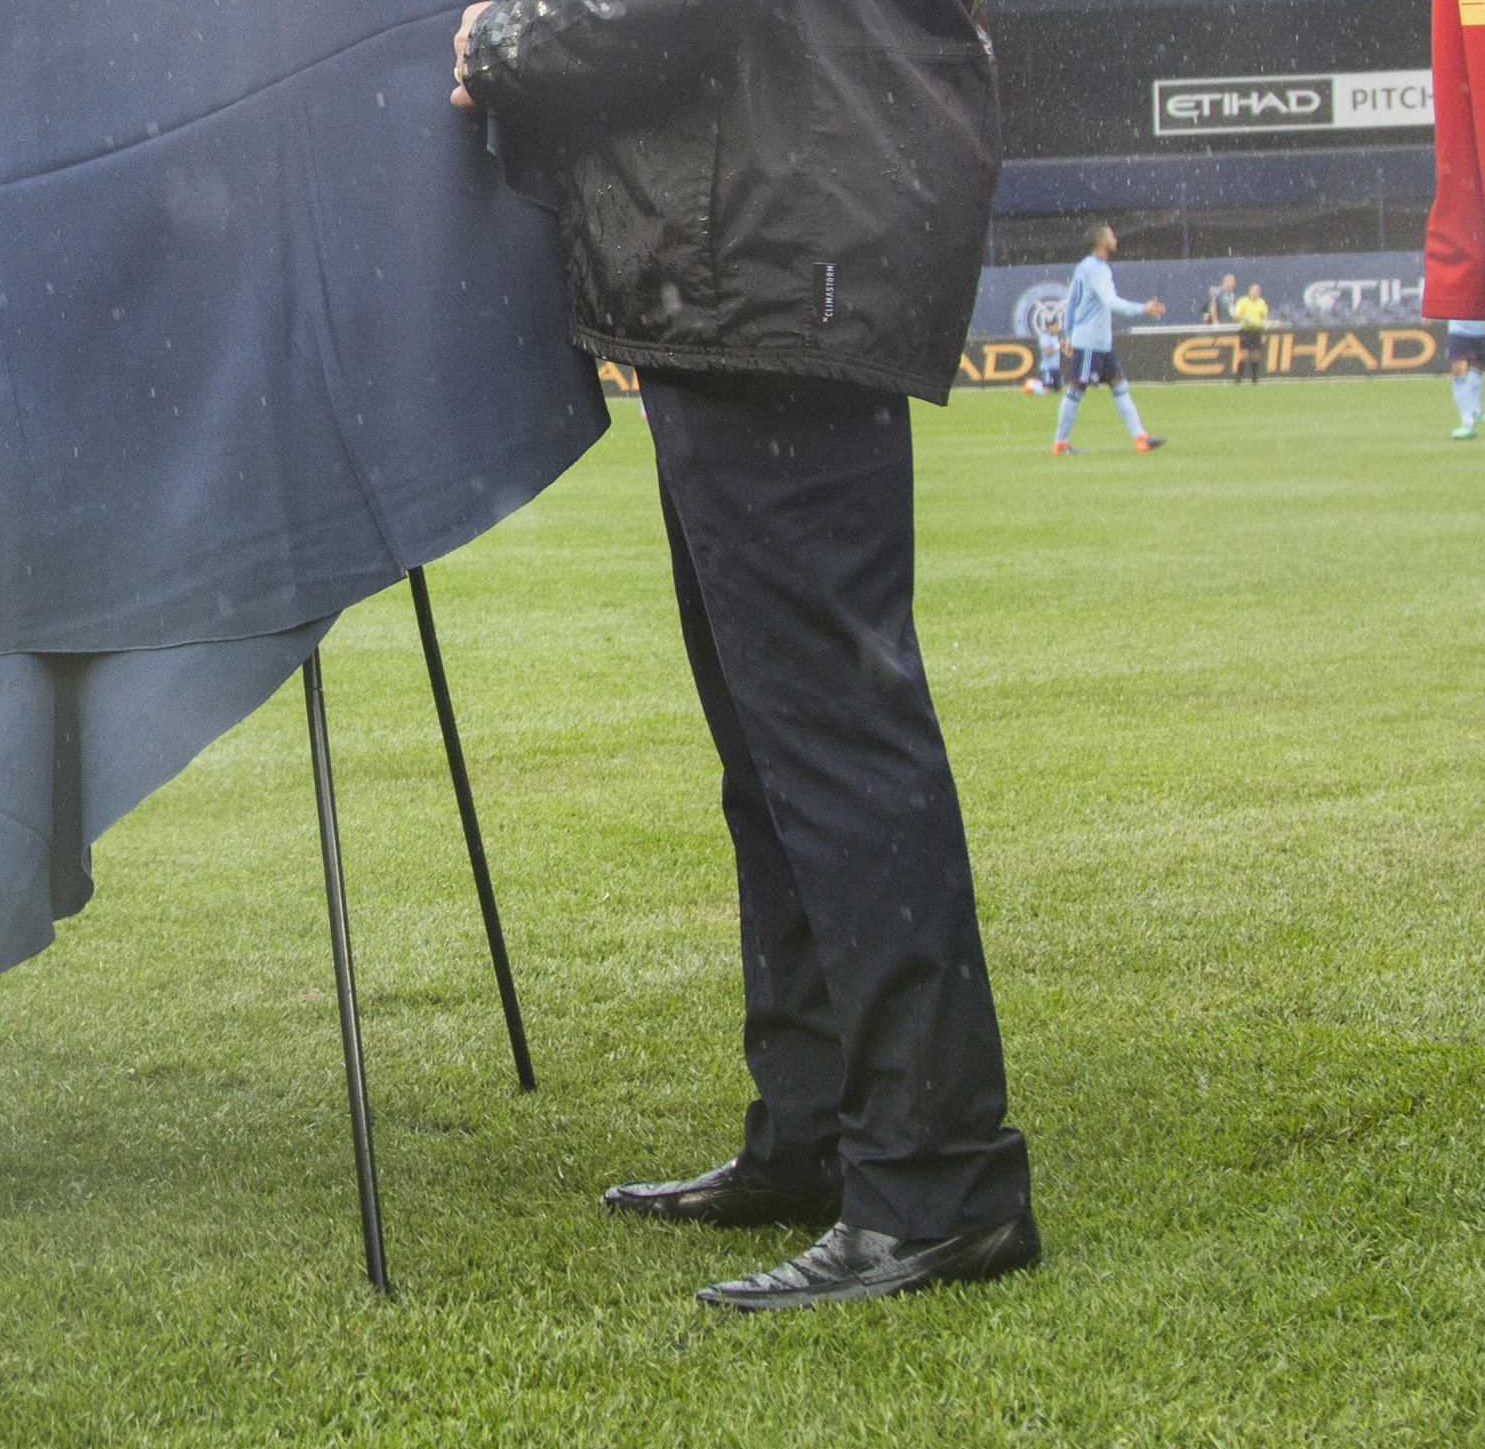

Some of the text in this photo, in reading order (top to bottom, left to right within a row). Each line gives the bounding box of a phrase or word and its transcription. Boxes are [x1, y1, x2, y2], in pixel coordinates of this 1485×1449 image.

[1167, 88, 1321, 118] ETIHAD
[824, 265, 835, 317] CLIMASTORM
[1173, 329, 1436, 377] ETIHAD
